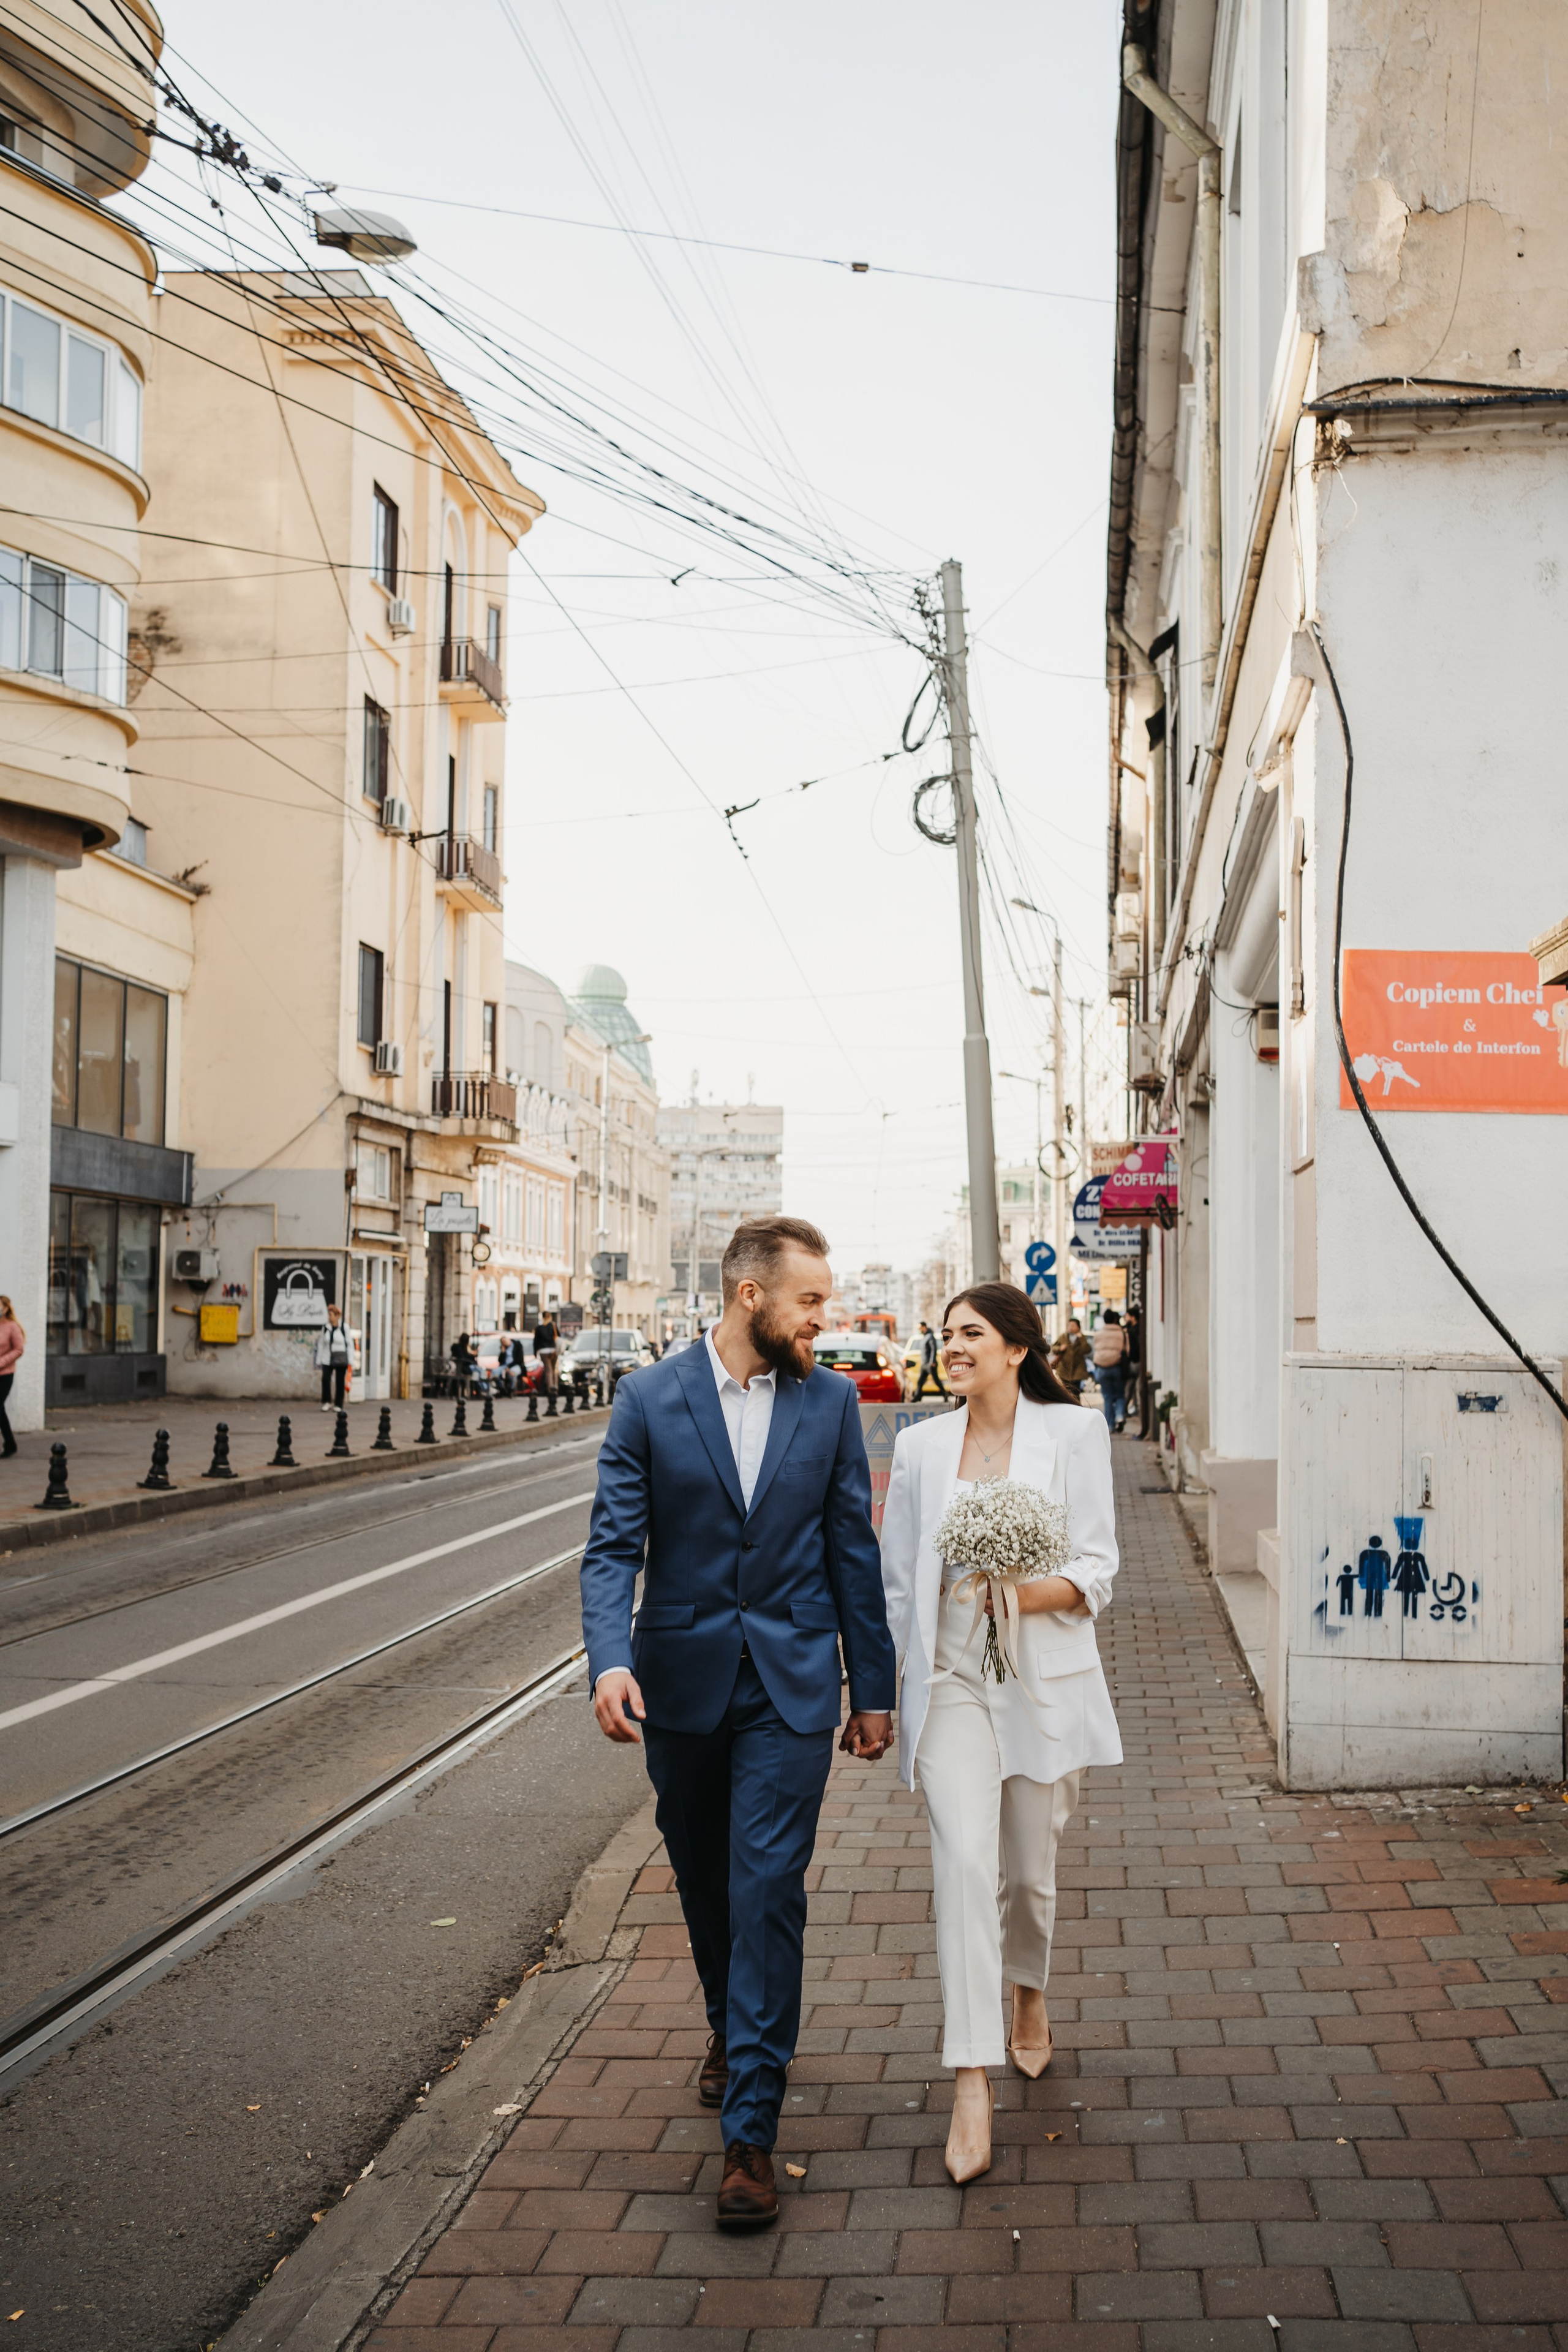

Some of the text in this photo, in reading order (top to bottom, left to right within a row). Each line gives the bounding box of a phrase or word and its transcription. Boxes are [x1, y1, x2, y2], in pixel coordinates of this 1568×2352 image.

[1386, 981, 1544, 1009] Copiem Chei
[1463, 1018, 1477, 1033] &
[1392, 1039, 1541, 1055] Cartele de Interfon
